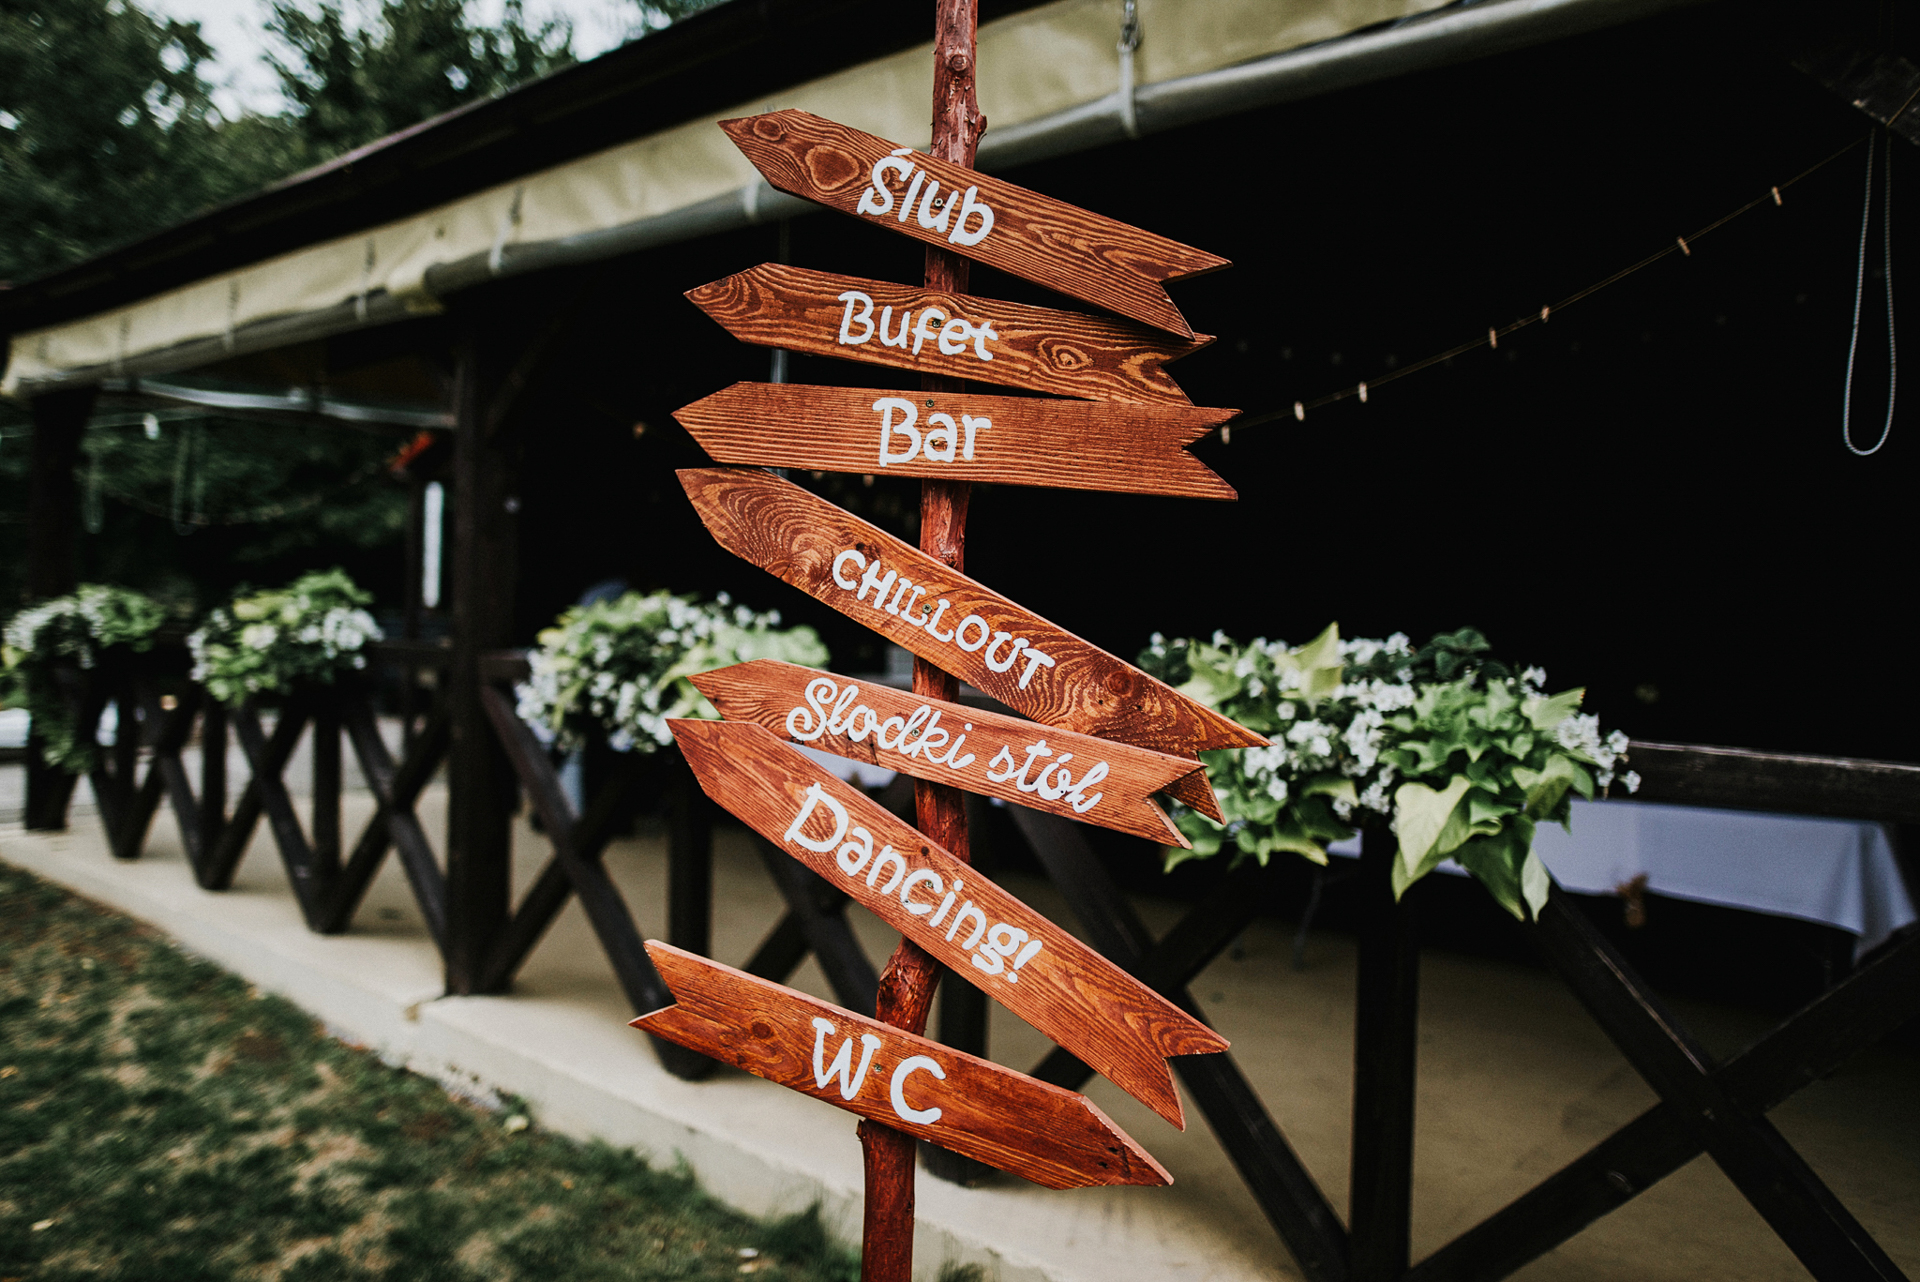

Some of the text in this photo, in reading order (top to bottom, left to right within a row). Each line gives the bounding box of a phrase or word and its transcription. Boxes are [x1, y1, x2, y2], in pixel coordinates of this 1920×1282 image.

[857, 148, 995, 247] Ślub
[837, 290, 999, 362] Bufet
[872, 397, 993, 467] Bar
[832, 549, 1056, 690] CHILLOUT
[783, 781, 1045, 984] Dancing!
[811, 1016, 947, 1126] WC
